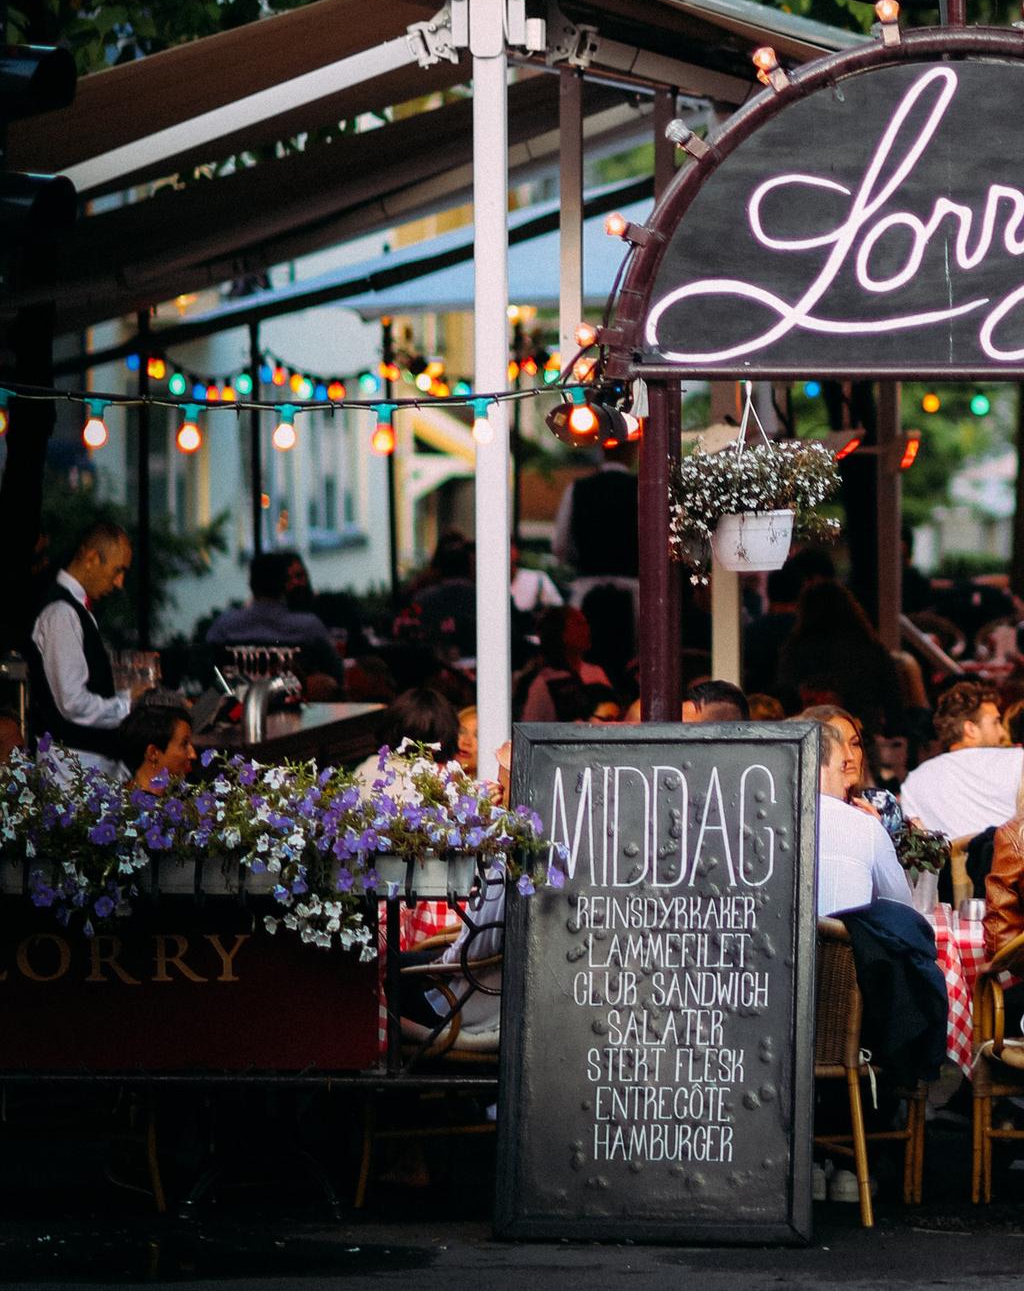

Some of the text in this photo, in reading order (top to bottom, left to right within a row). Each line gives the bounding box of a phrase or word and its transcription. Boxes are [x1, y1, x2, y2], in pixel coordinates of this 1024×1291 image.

[545, 764, 777, 887] MIDDAG
[575, 896, 757, 930] REINSDYRKAKER
[0, 931, 251, 986] ORRY
[588, 933, 752, 968] LAMMEFILET
[573, 971, 769, 1007] CLUB SANDWICH
[607, 1009, 724, 1046] SALATER
[587, 1048, 745, 1083] STEKT FLESK
[595, 1083, 731, 1122] ENTRECÔTE
[593, 1124, 734, 1162] HAMBURGER
